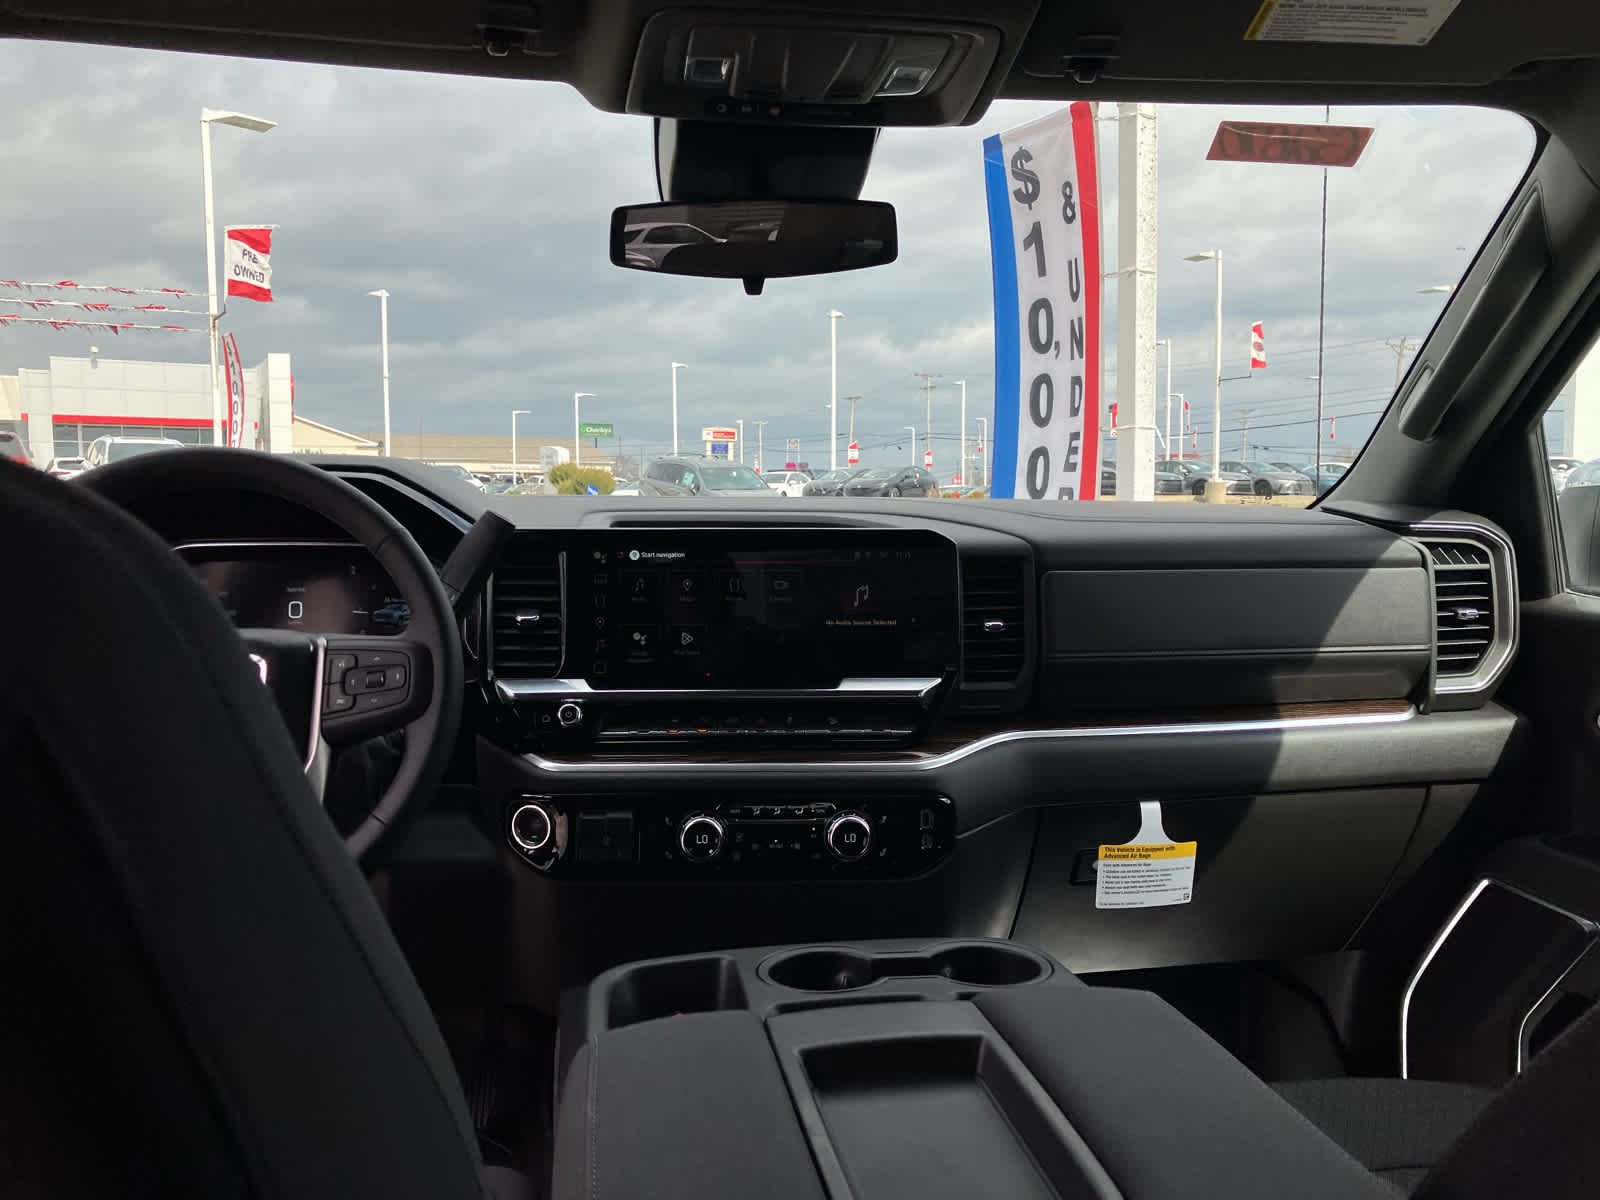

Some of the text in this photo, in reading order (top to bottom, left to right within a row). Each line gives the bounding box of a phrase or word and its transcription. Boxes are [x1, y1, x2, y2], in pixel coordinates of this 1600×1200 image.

[1061, 180, 1077, 225] &
[241, 247, 259, 264] PRE
[233, 263, 265, 284] OWNED
[288, 600, 303, 619] 0
[695, 834, 709, 845] LO
[843, 833, 856, 843] LO
